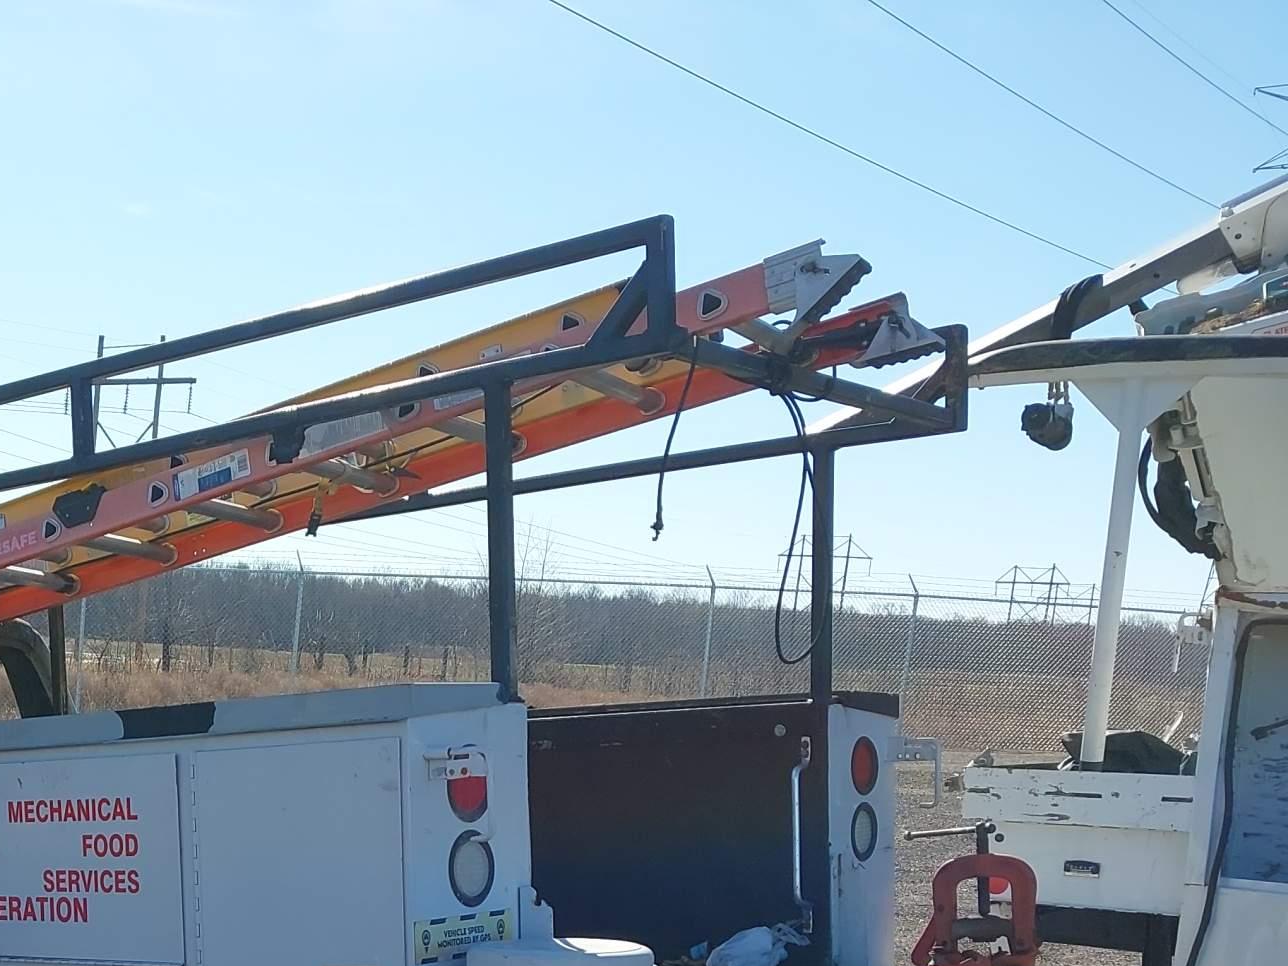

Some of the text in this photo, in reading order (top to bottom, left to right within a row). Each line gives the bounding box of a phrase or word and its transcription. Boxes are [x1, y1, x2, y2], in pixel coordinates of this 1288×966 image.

[7, 797, 139, 824] MECHANICAL
[81, 833, 139, 858] FOOD
[42, 869, 140, 894] SERVICES
[437, 932, 492, 948] MONITORED BY GPS
[443, 925, 485, 938] VEHICLE SPEED
